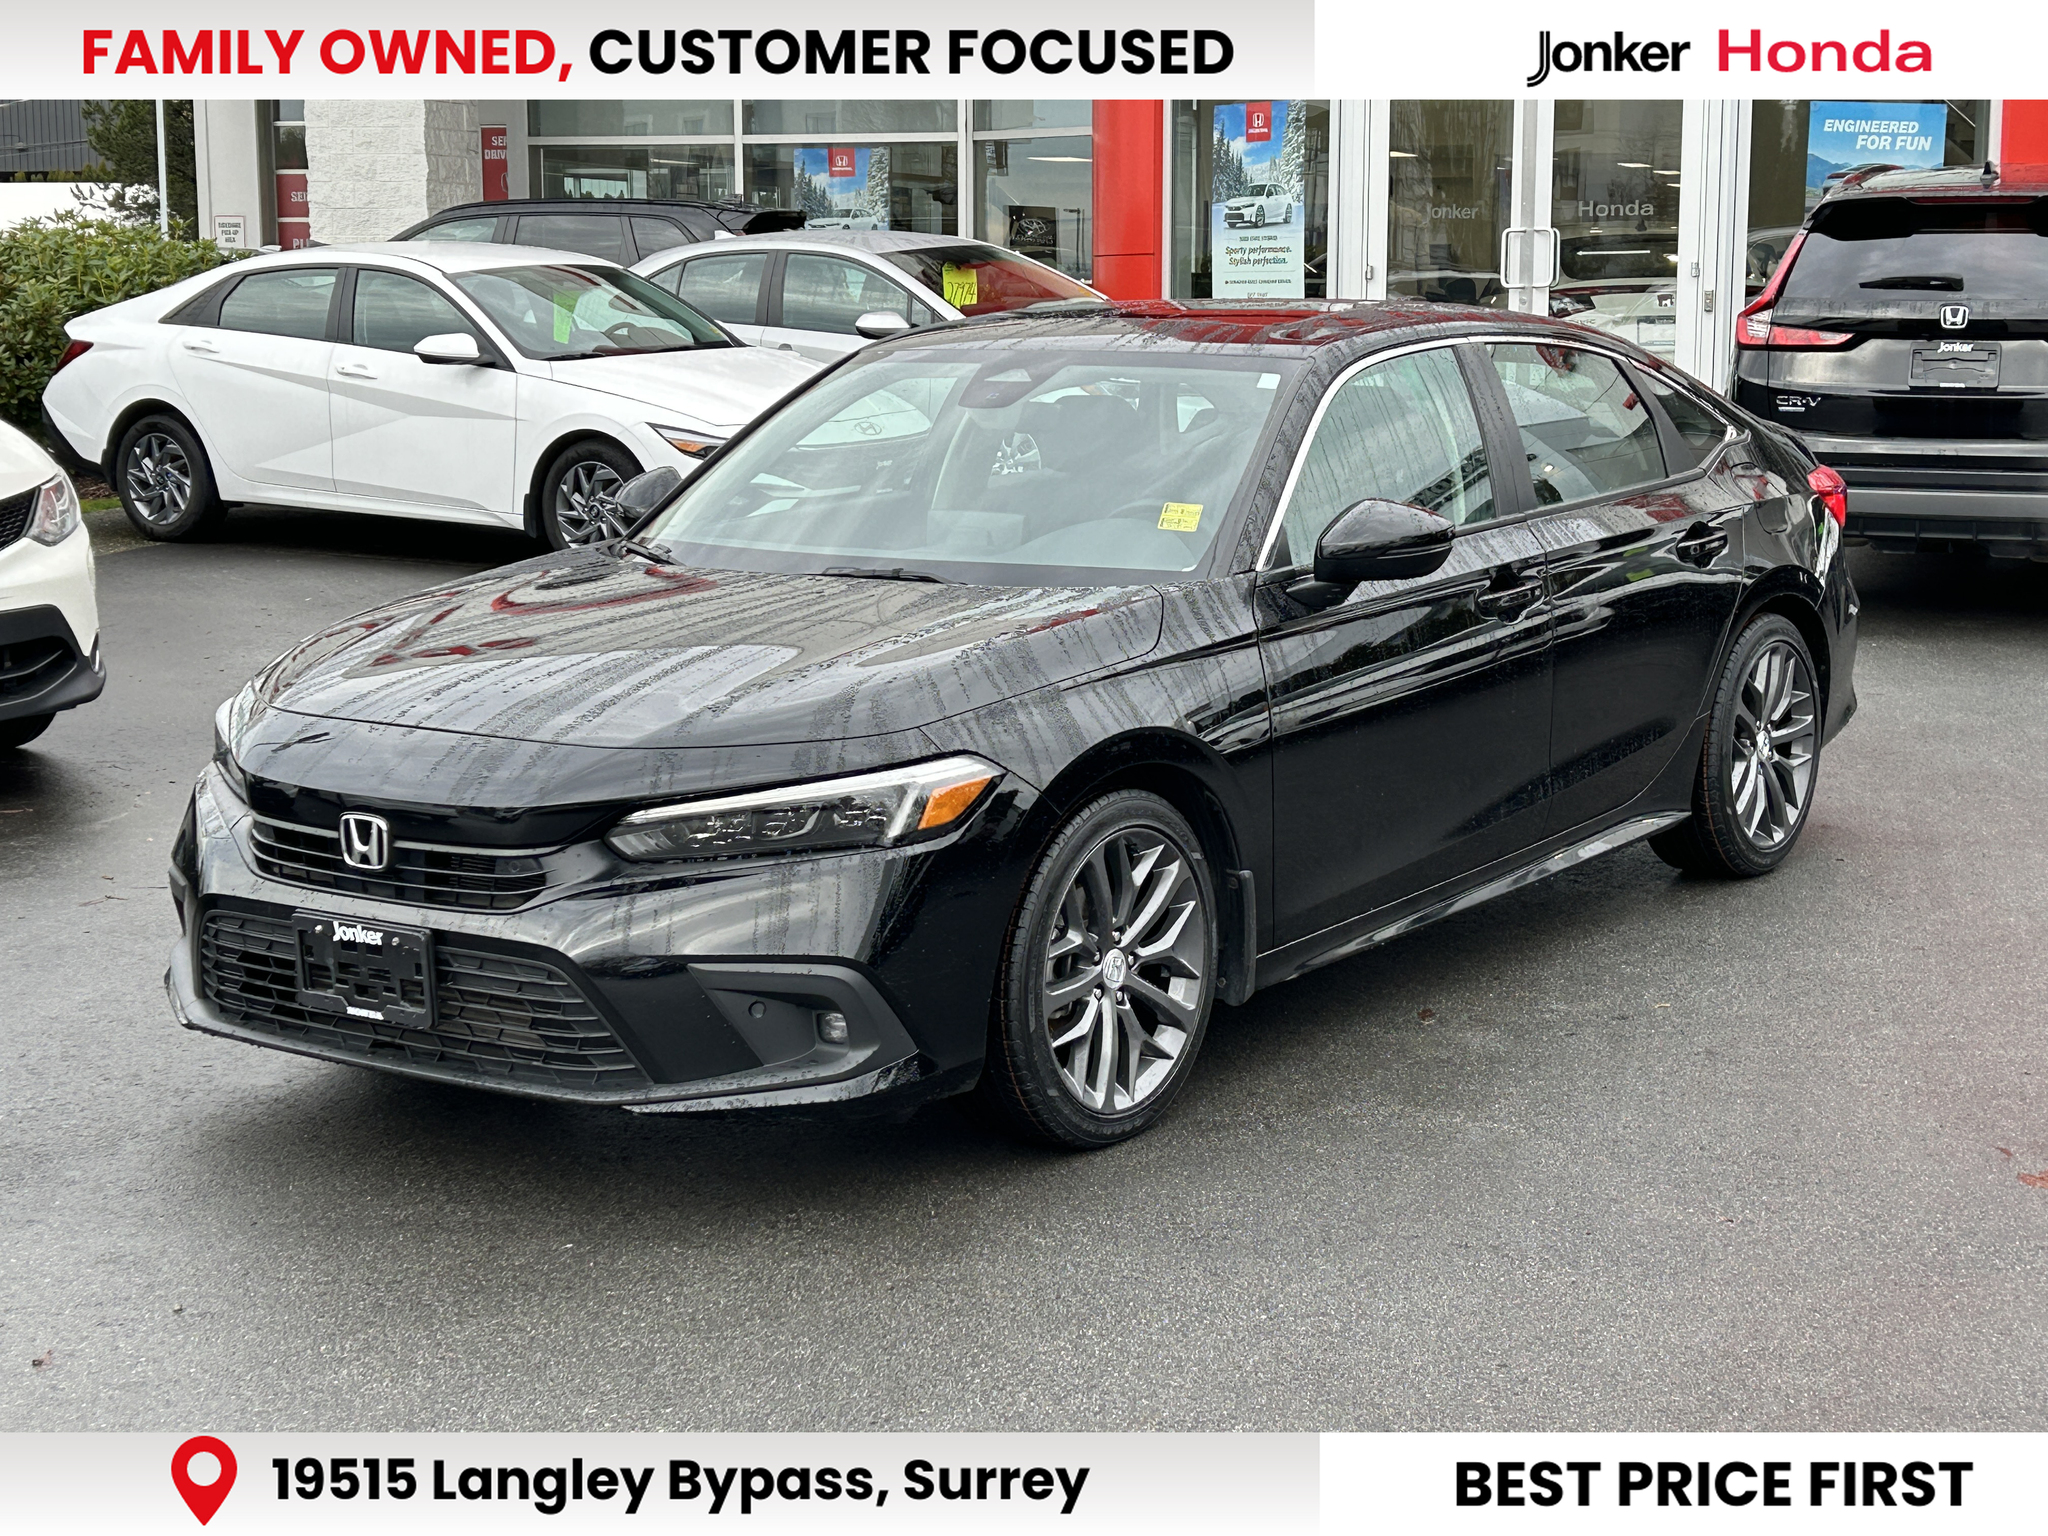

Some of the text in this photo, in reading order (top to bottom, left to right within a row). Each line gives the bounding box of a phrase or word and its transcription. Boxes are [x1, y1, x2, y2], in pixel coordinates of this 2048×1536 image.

[1823, 119, 1919, 133] ENGINEERED
[1855, 135, 1932, 151] FOR FUN
[1423, 203, 1479, 224] Jonker
[1578, 200, 1654, 217] Honda
[1225, 246, 1247, 256] Sporty
[1937, 341, 1975, 354] Jonker
[1776, 395, 1821, 407] CR-V
[332, 920, 384, 946] Jonker
